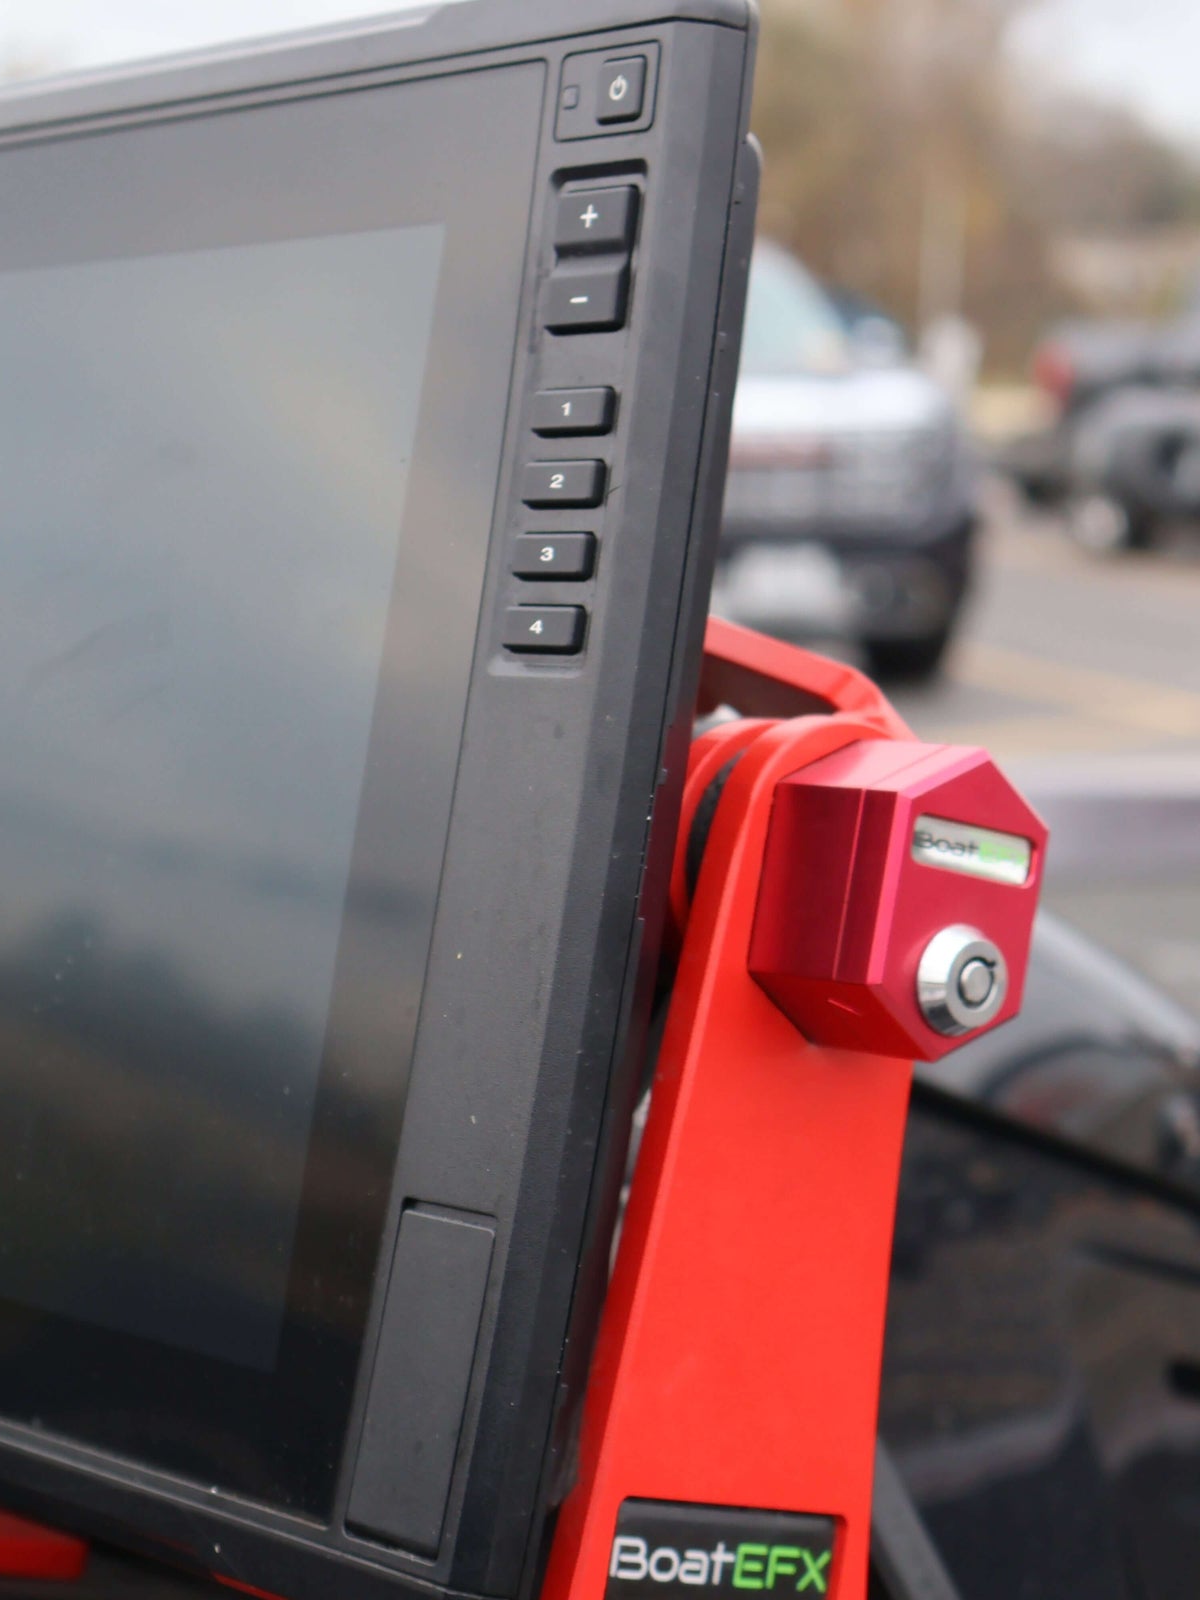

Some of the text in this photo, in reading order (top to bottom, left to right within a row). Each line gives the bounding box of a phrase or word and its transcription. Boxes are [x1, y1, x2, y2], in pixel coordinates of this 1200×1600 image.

[560, 401, 571, 417] 1
[549, 473, 564, 489] 2
[540, 546, 555, 562] 3
[529, 619, 544, 634] 4
[912, 829, 1027, 866] Boat
[608, 1535, 832, 1594] BoatEFX
